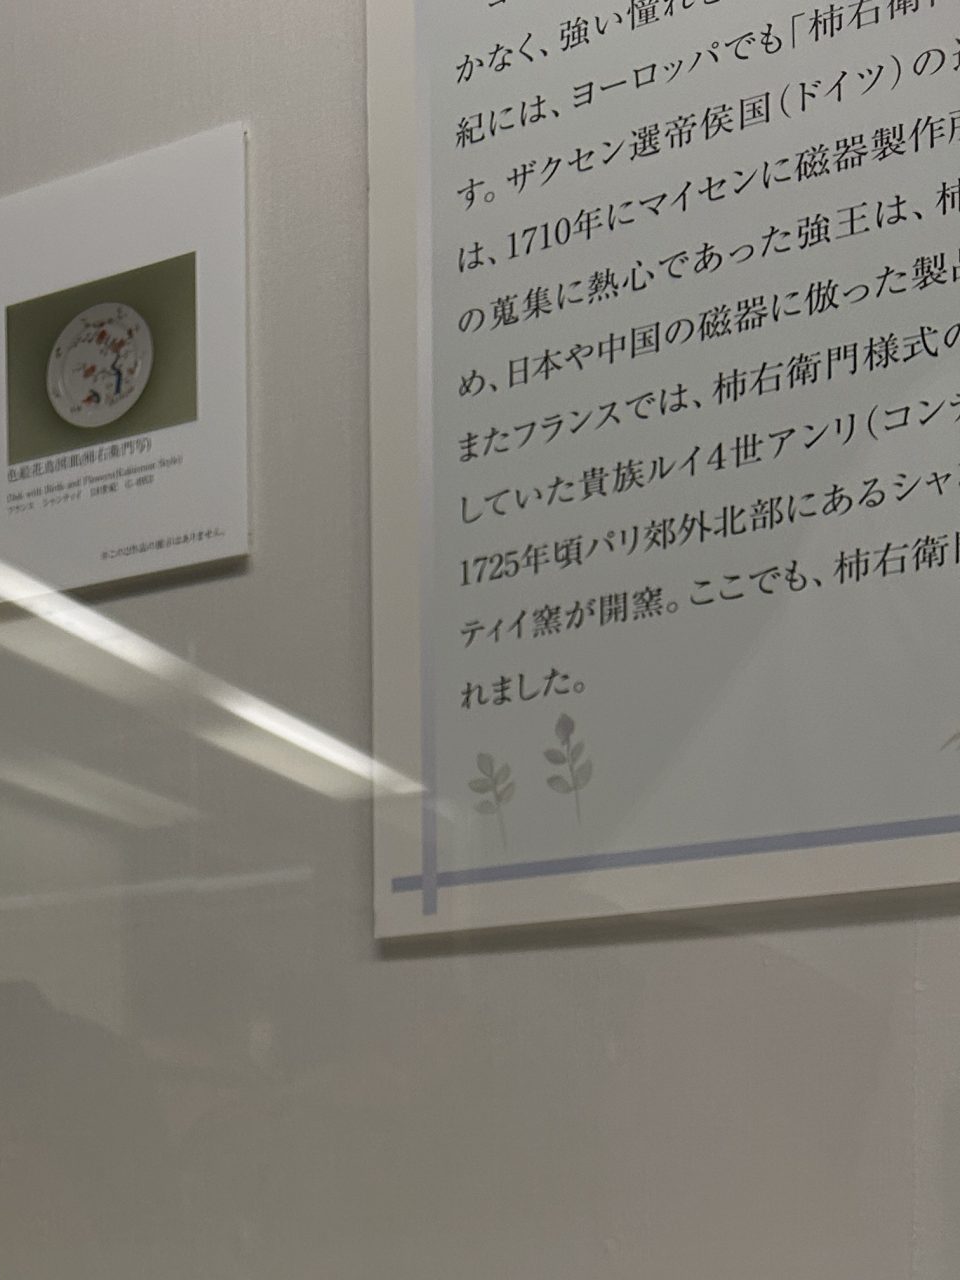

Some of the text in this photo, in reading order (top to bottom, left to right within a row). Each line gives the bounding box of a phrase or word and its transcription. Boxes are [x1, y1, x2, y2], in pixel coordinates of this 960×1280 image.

[456, 0, 938, 149] 紀には、ヨーロッパでも「柿右衛
[460, 463, 960, 587] 1725年頃パリ郊外北部にあるシャ
[460, 530, 960, 649] ティイ窯が開窯。ここでも、柿右衛
[460, 667, 586, 710] れました。
